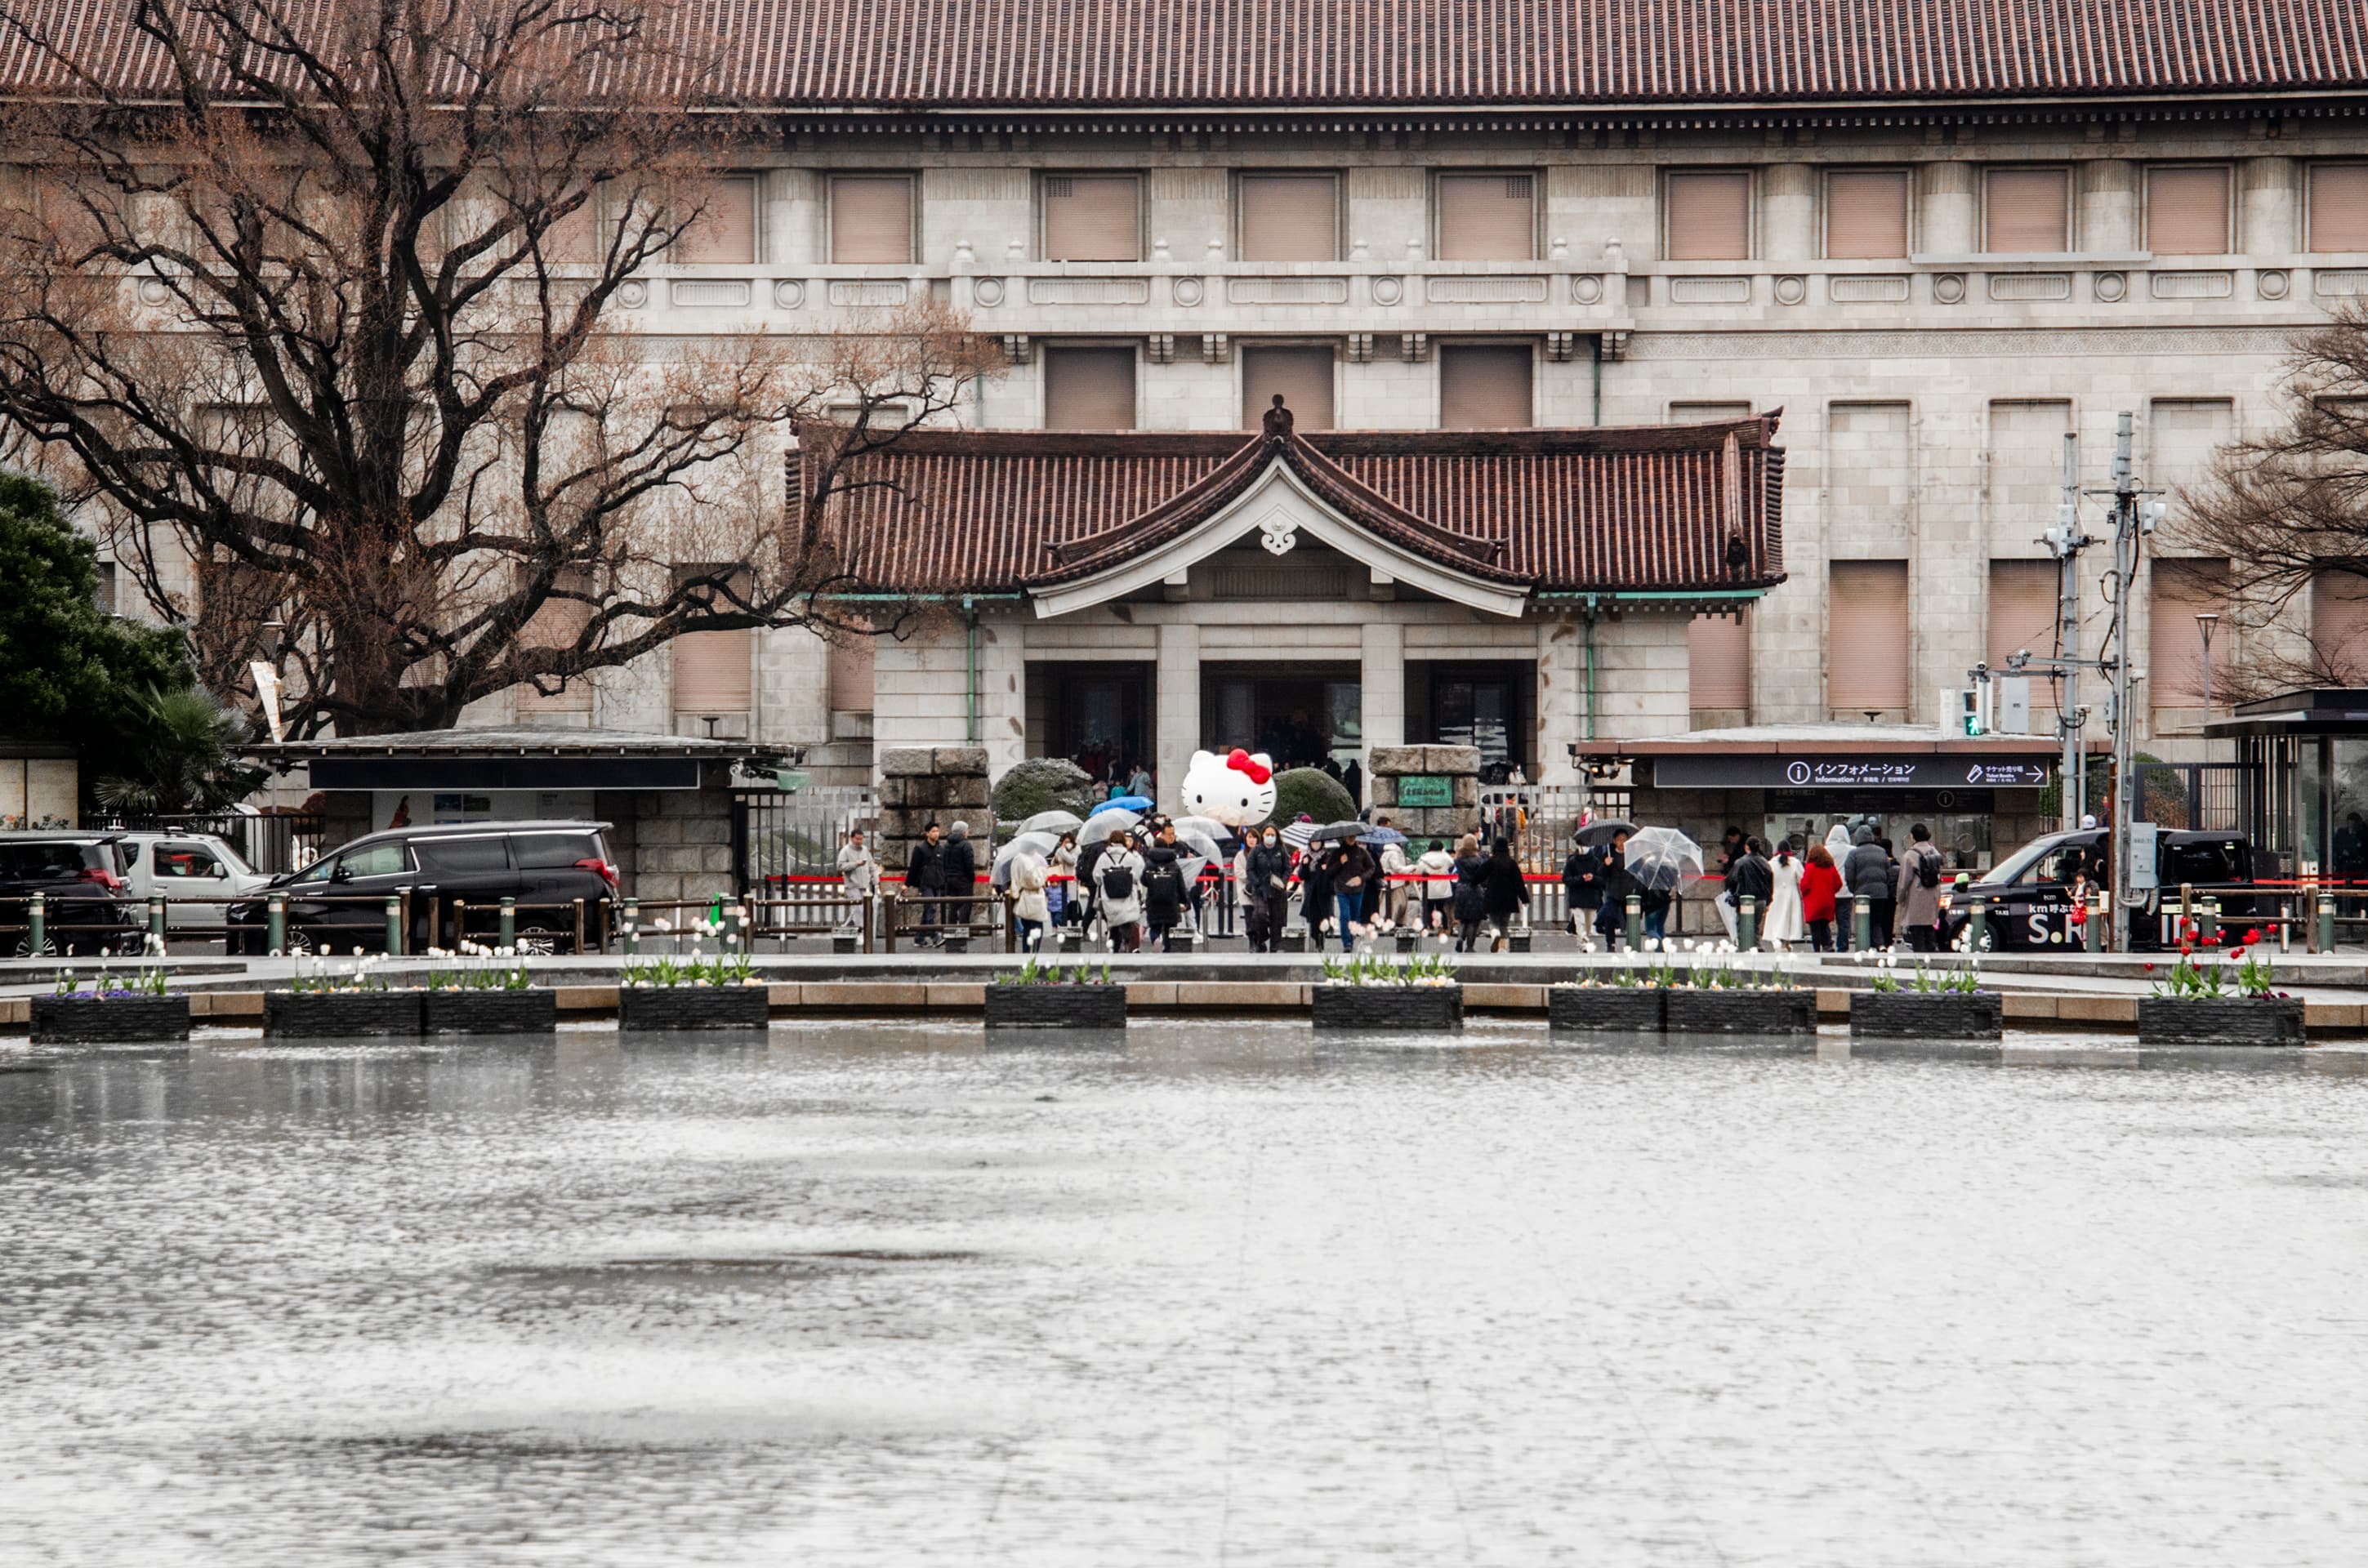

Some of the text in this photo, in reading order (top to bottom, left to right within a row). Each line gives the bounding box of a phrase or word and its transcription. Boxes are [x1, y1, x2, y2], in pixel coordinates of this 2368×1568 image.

[1814, 763, 1915, 775] インフォメーション
